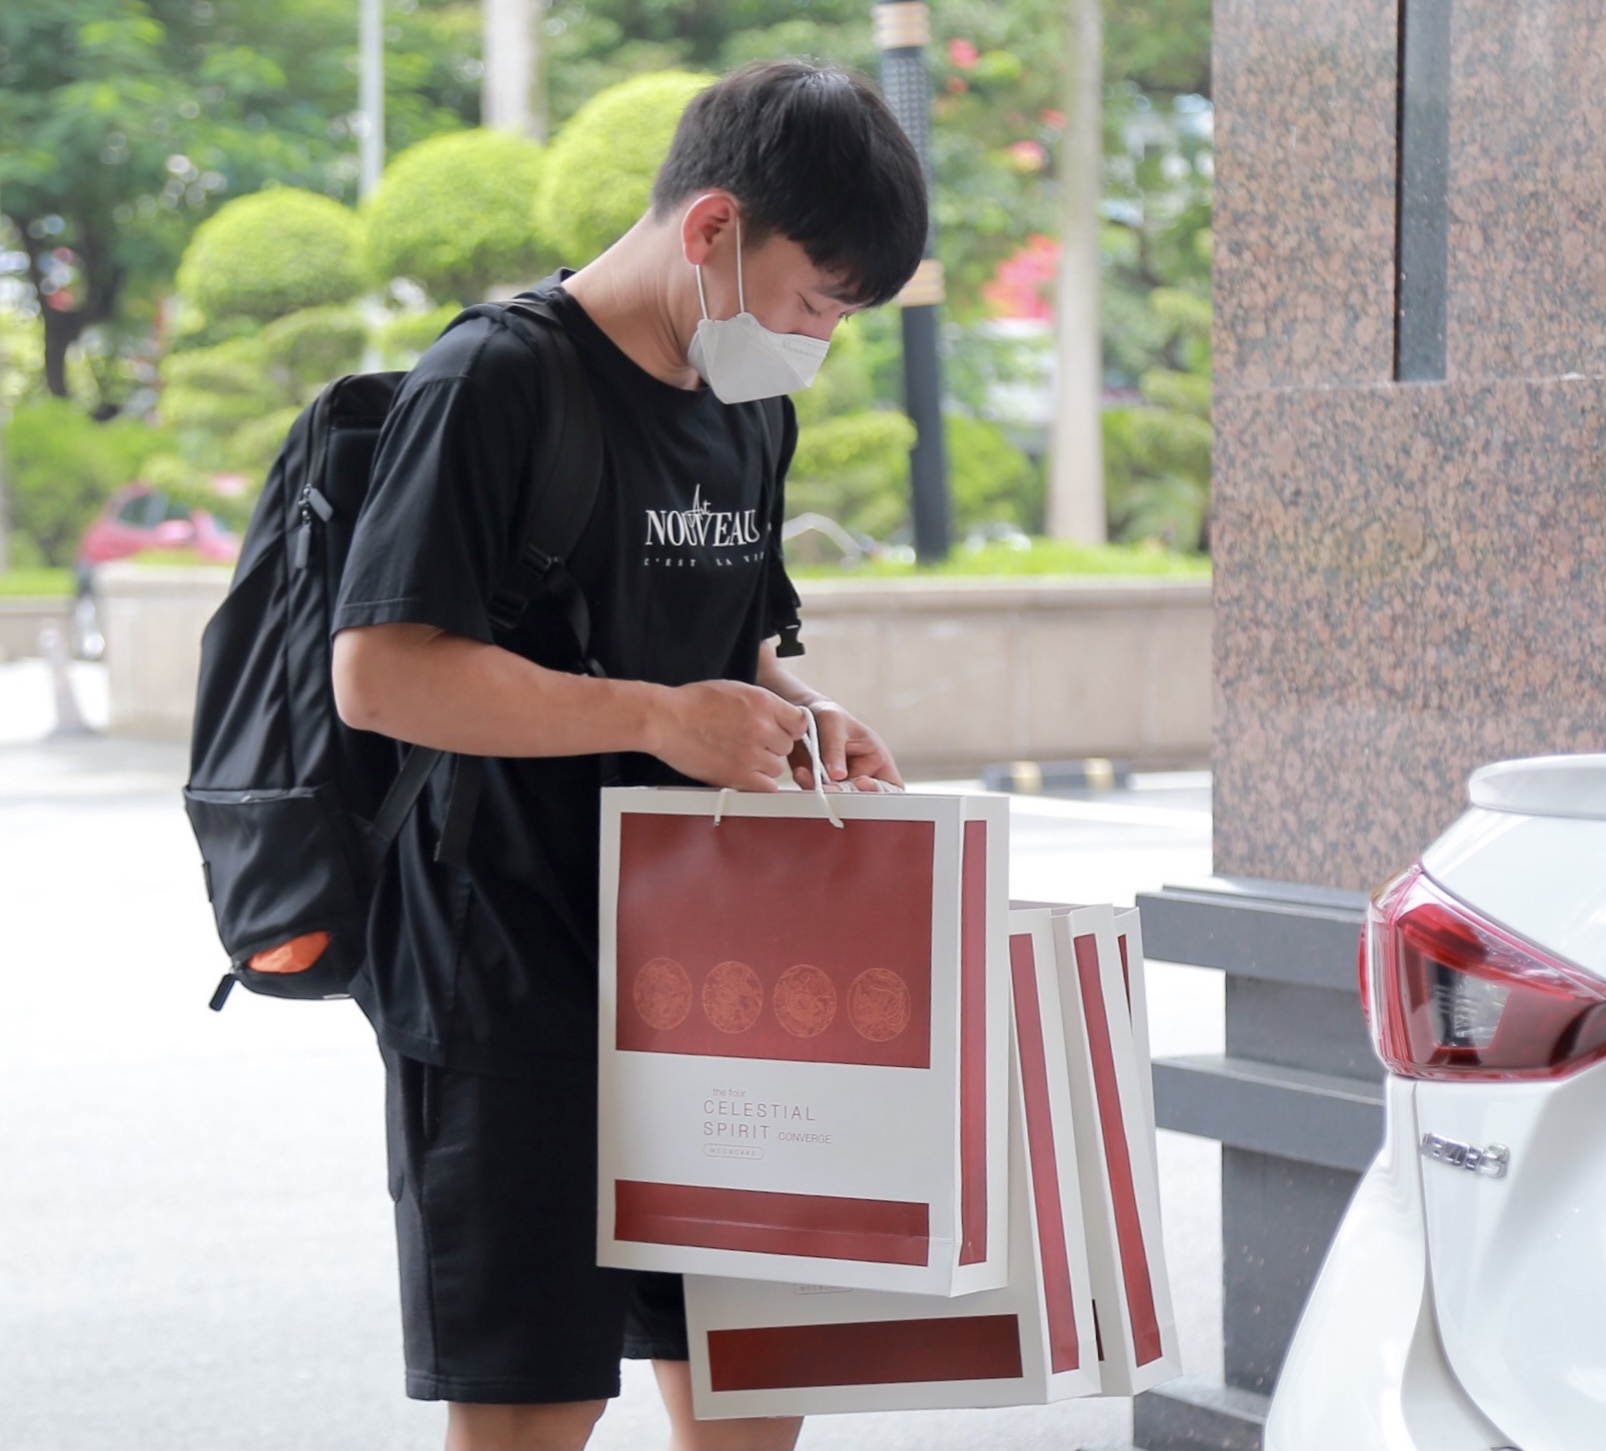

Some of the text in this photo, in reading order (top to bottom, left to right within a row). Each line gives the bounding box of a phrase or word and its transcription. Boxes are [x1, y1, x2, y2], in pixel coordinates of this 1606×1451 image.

[644, 508, 760, 547] NOUVEAU
[643, 557, 697, 567] C'EST
[715, 557, 733, 567] LA
[712, 1088, 747, 1098] the four
[703, 1099, 816, 1121] CELESTIAL
[703, 1121, 833, 1145] SPIRIT CONVERGE
